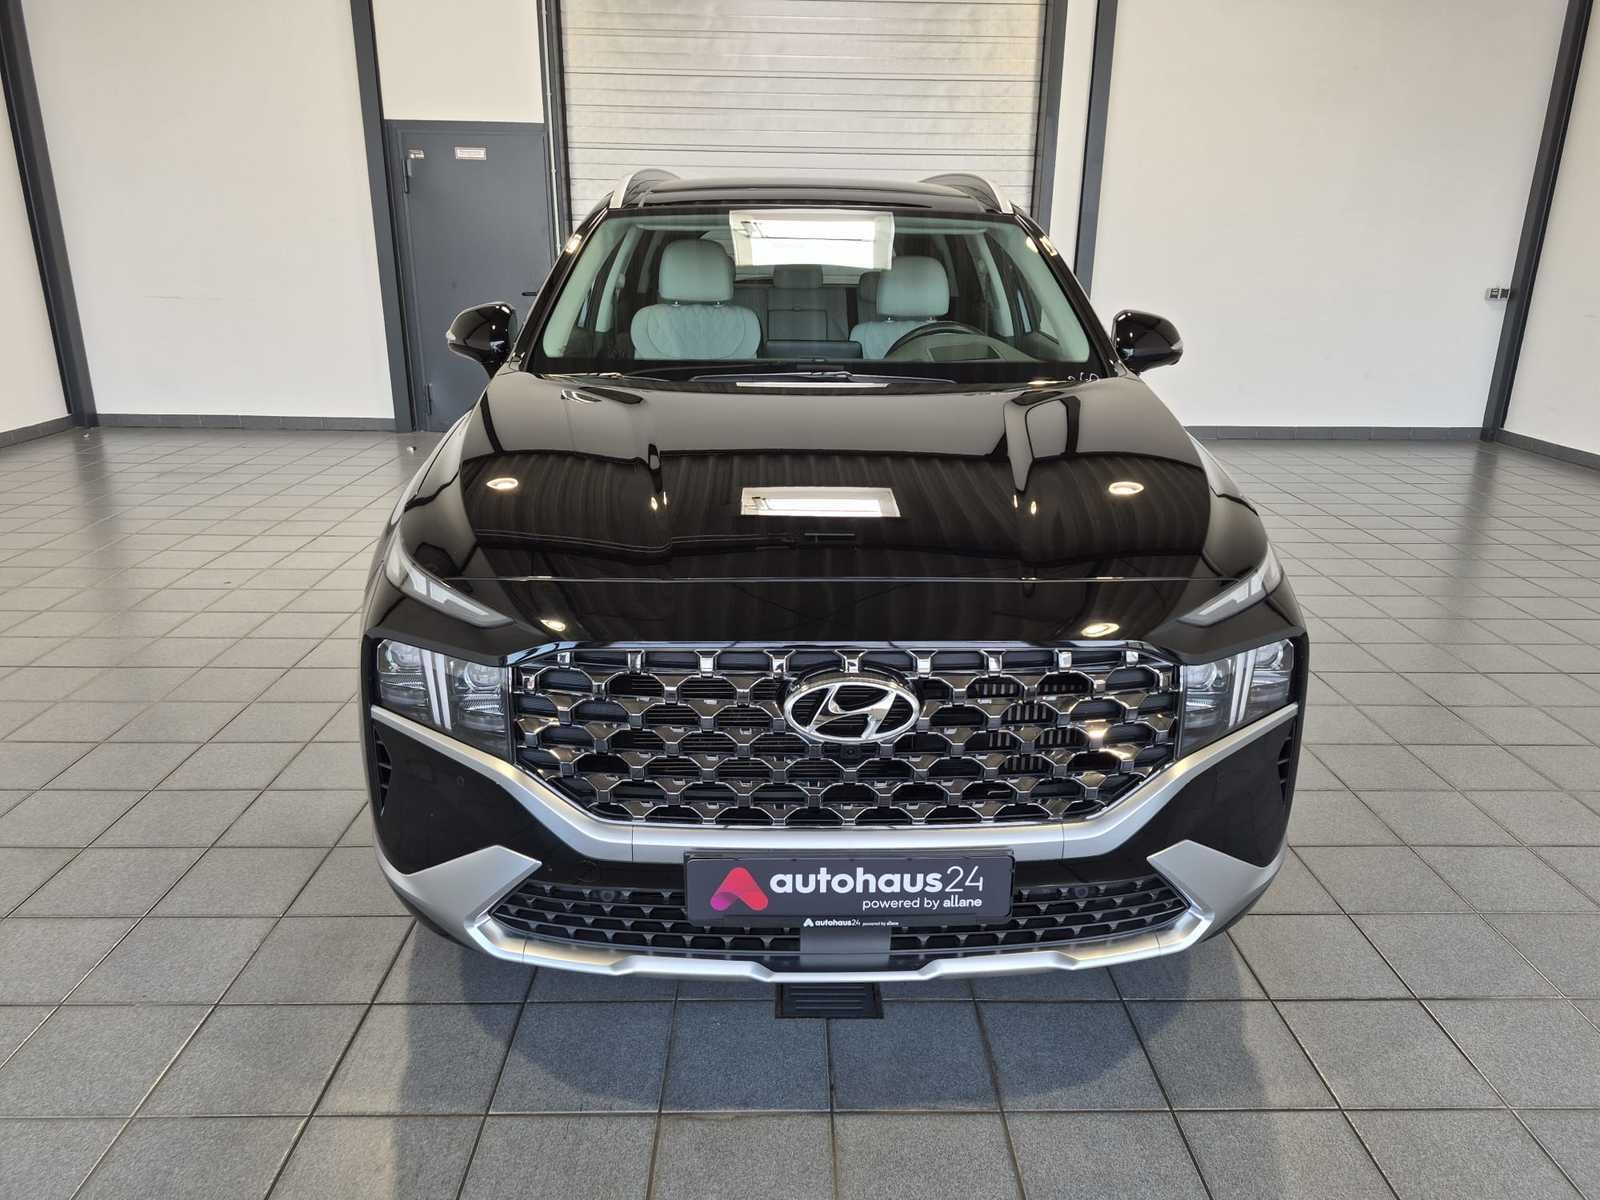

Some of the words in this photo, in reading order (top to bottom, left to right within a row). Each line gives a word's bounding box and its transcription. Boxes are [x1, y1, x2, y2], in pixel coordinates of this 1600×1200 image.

[770, 866, 984, 893] autohaus24
[862, 897, 920, 910] powered
[924, 897, 940, 911] by
[943, 895, 983, 908] allane
[815, 919, 860, 927] autohaus24
